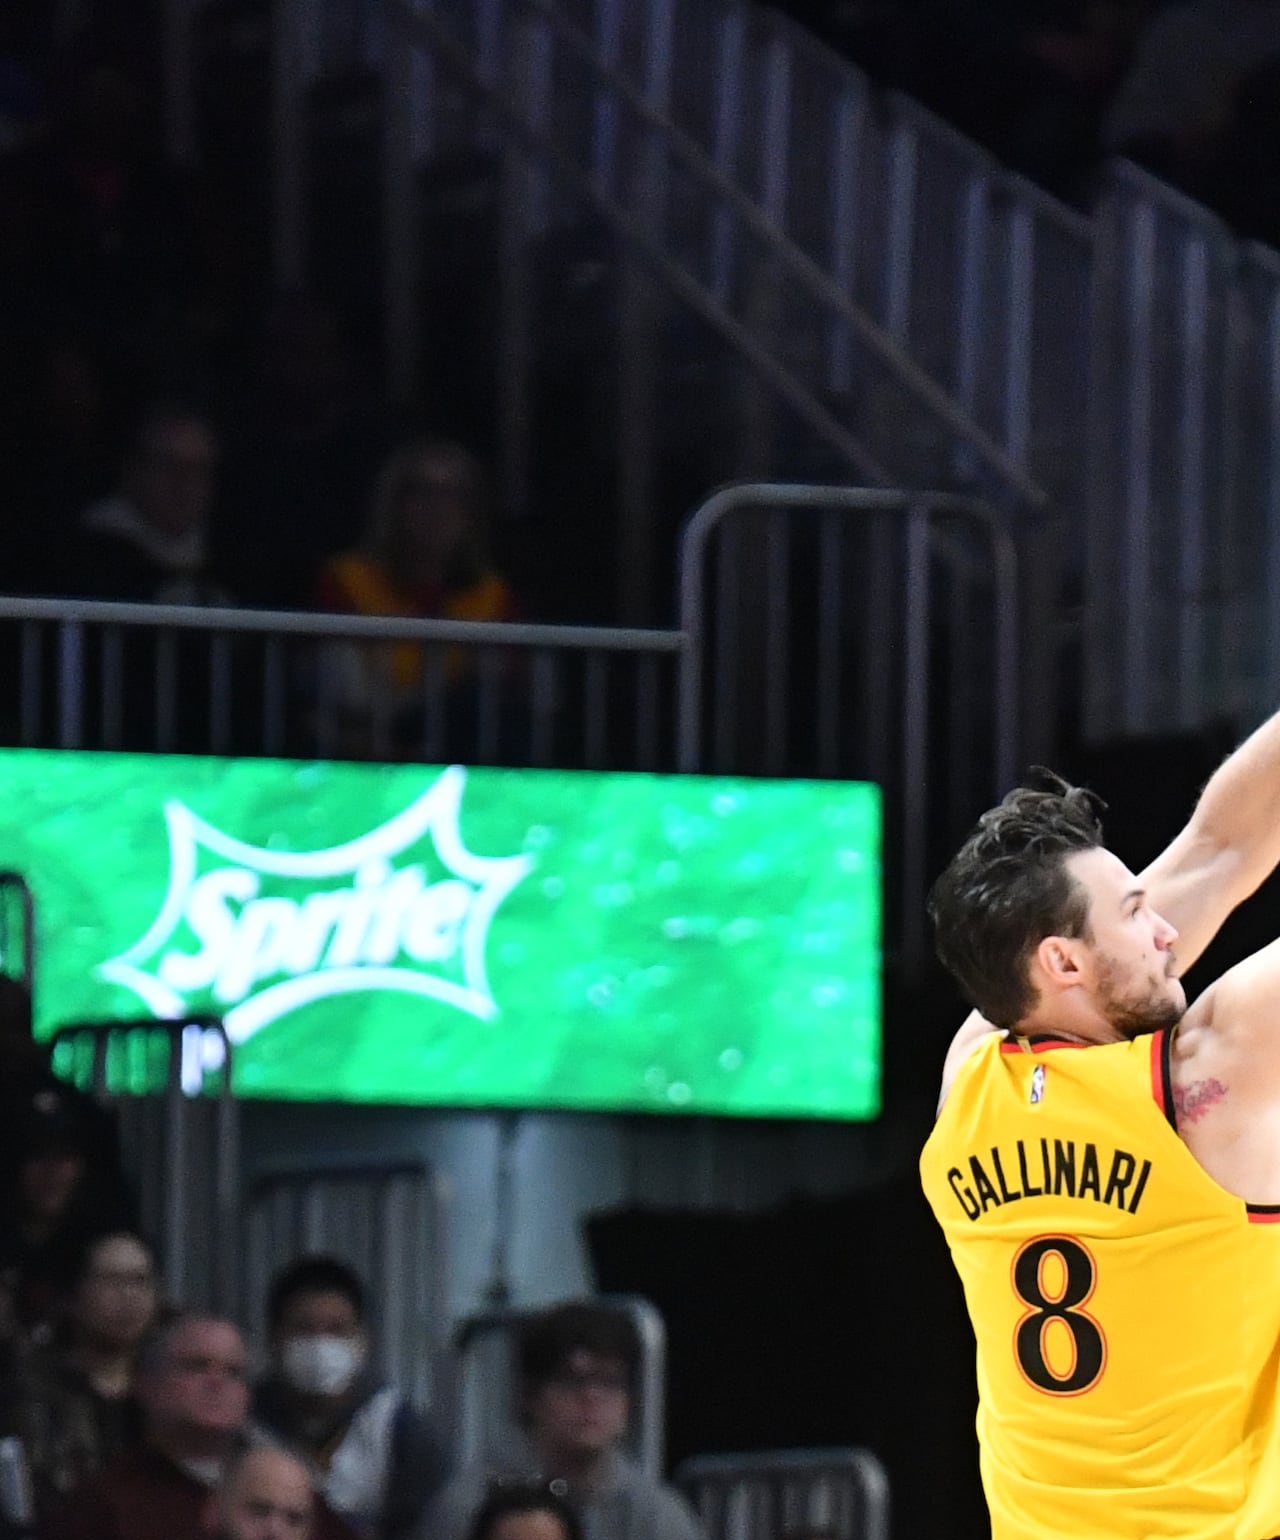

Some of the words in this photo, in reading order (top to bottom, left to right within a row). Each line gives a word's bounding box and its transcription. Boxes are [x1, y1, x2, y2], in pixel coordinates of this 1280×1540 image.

[160, 853, 472, 1003] Sprite
[946, 1137, 1152, 1222] GALLINARI
[1010, 1232, 1108, 1398] 8
